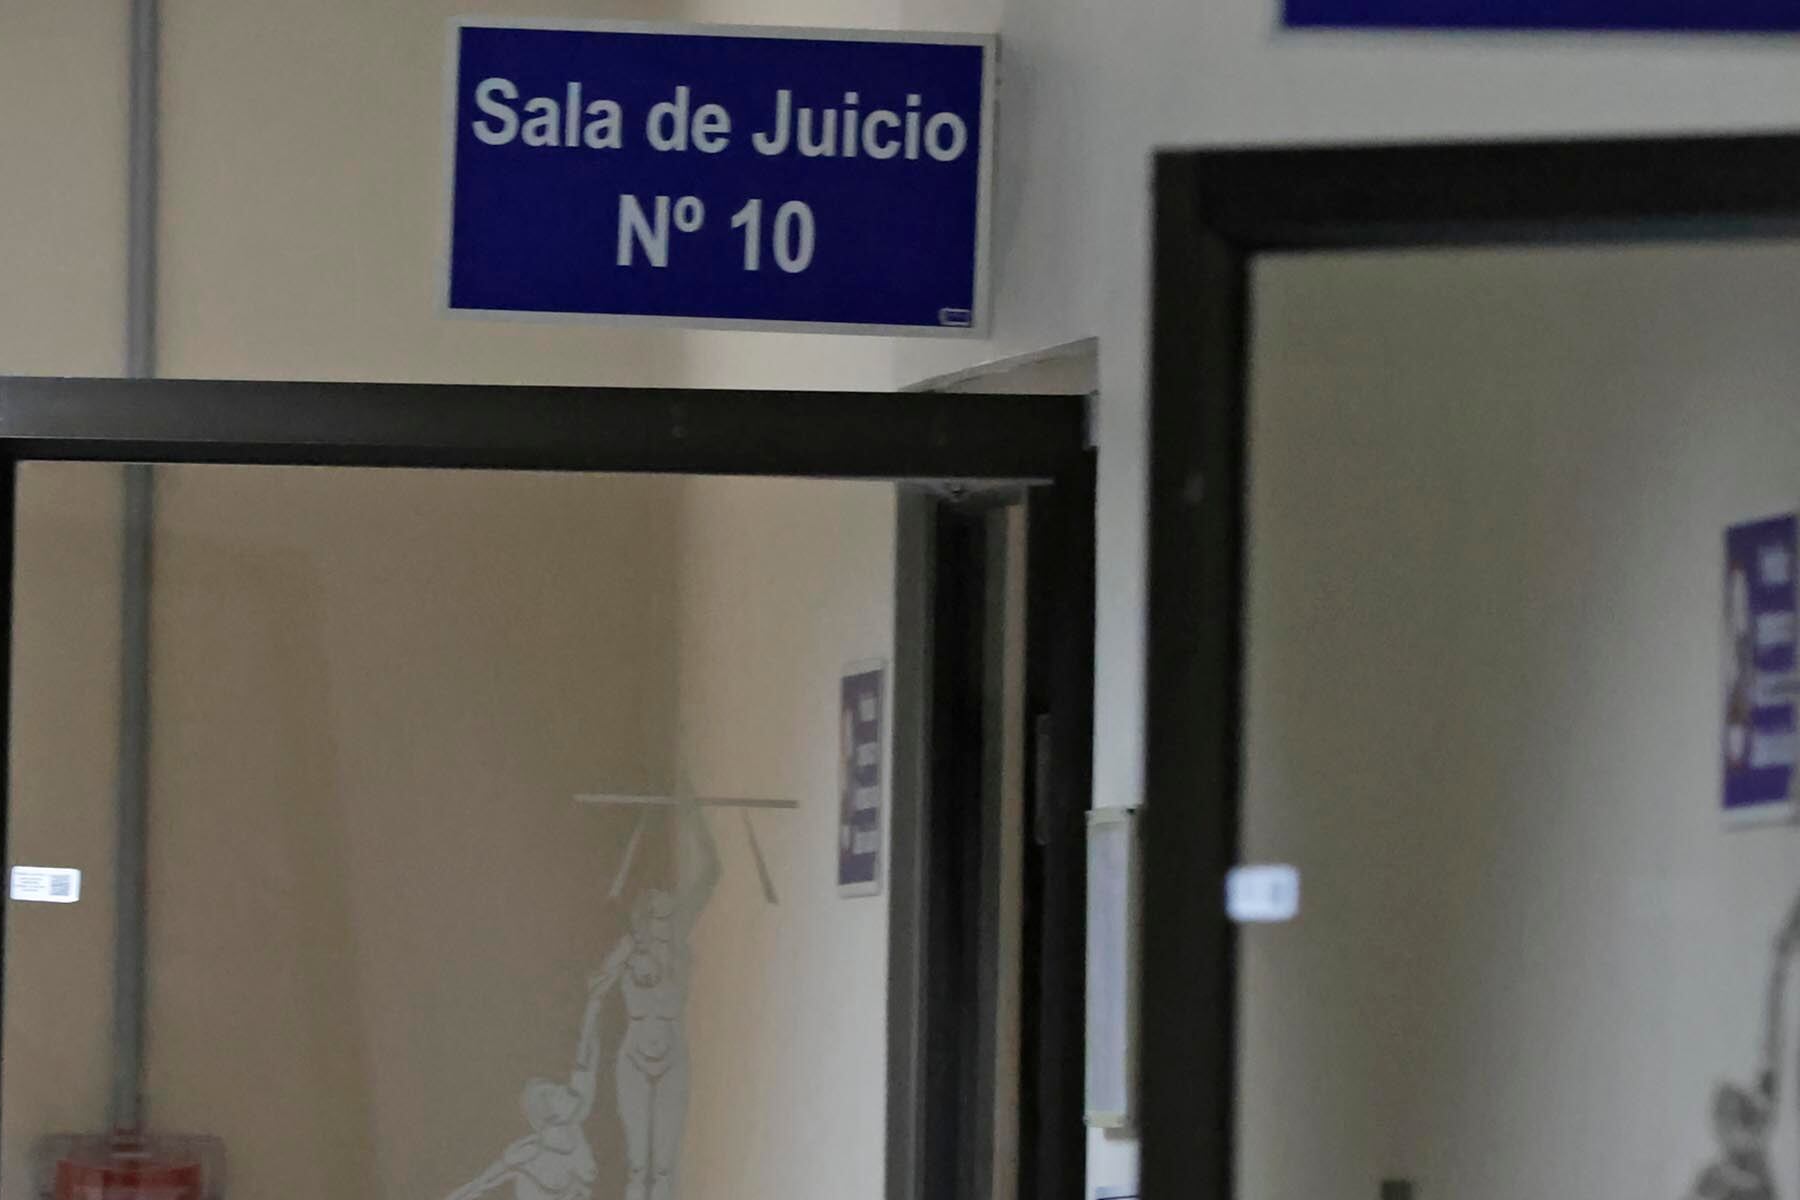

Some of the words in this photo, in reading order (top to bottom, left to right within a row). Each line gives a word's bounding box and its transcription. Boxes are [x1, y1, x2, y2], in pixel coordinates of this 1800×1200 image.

[472, 76, 623, 149] Sala
[646, 85, 732, 154] de
[752, 89, 968, 162] Juicio
[730, 197, 816, 273] 10
